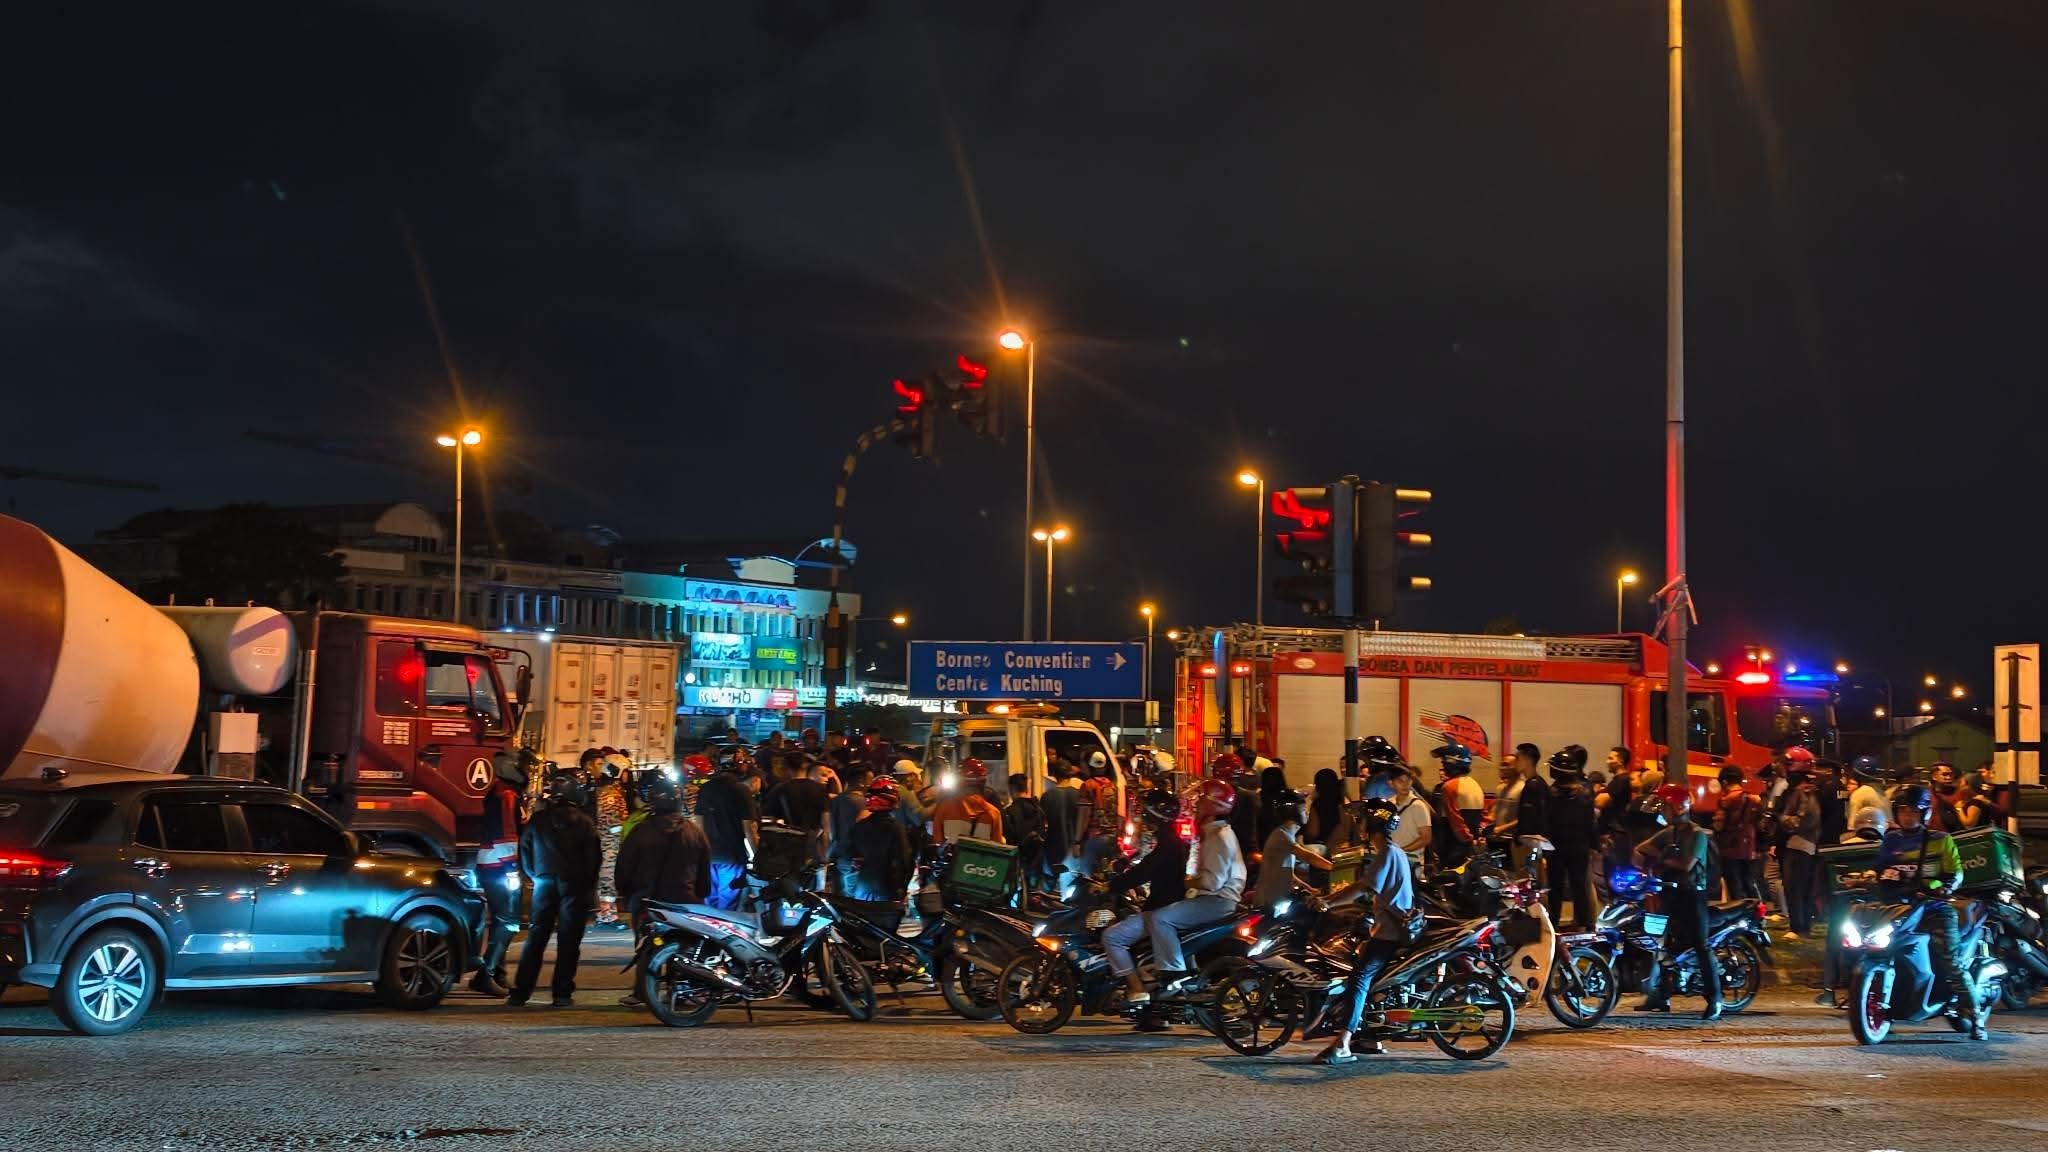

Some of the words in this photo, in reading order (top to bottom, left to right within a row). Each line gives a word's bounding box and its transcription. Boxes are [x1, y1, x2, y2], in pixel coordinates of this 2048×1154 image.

[936, 650, 991, 668] Borneo
[1004, 651, 1091, 669] Convention
[1413, 660, 1443, 673] DAN
[936, 674, 989, 691] Centre
[1000, 674, 1063, 696] Kuching
[471, 760, 489, 784] A
[963, 863, 997, 878] Grab
